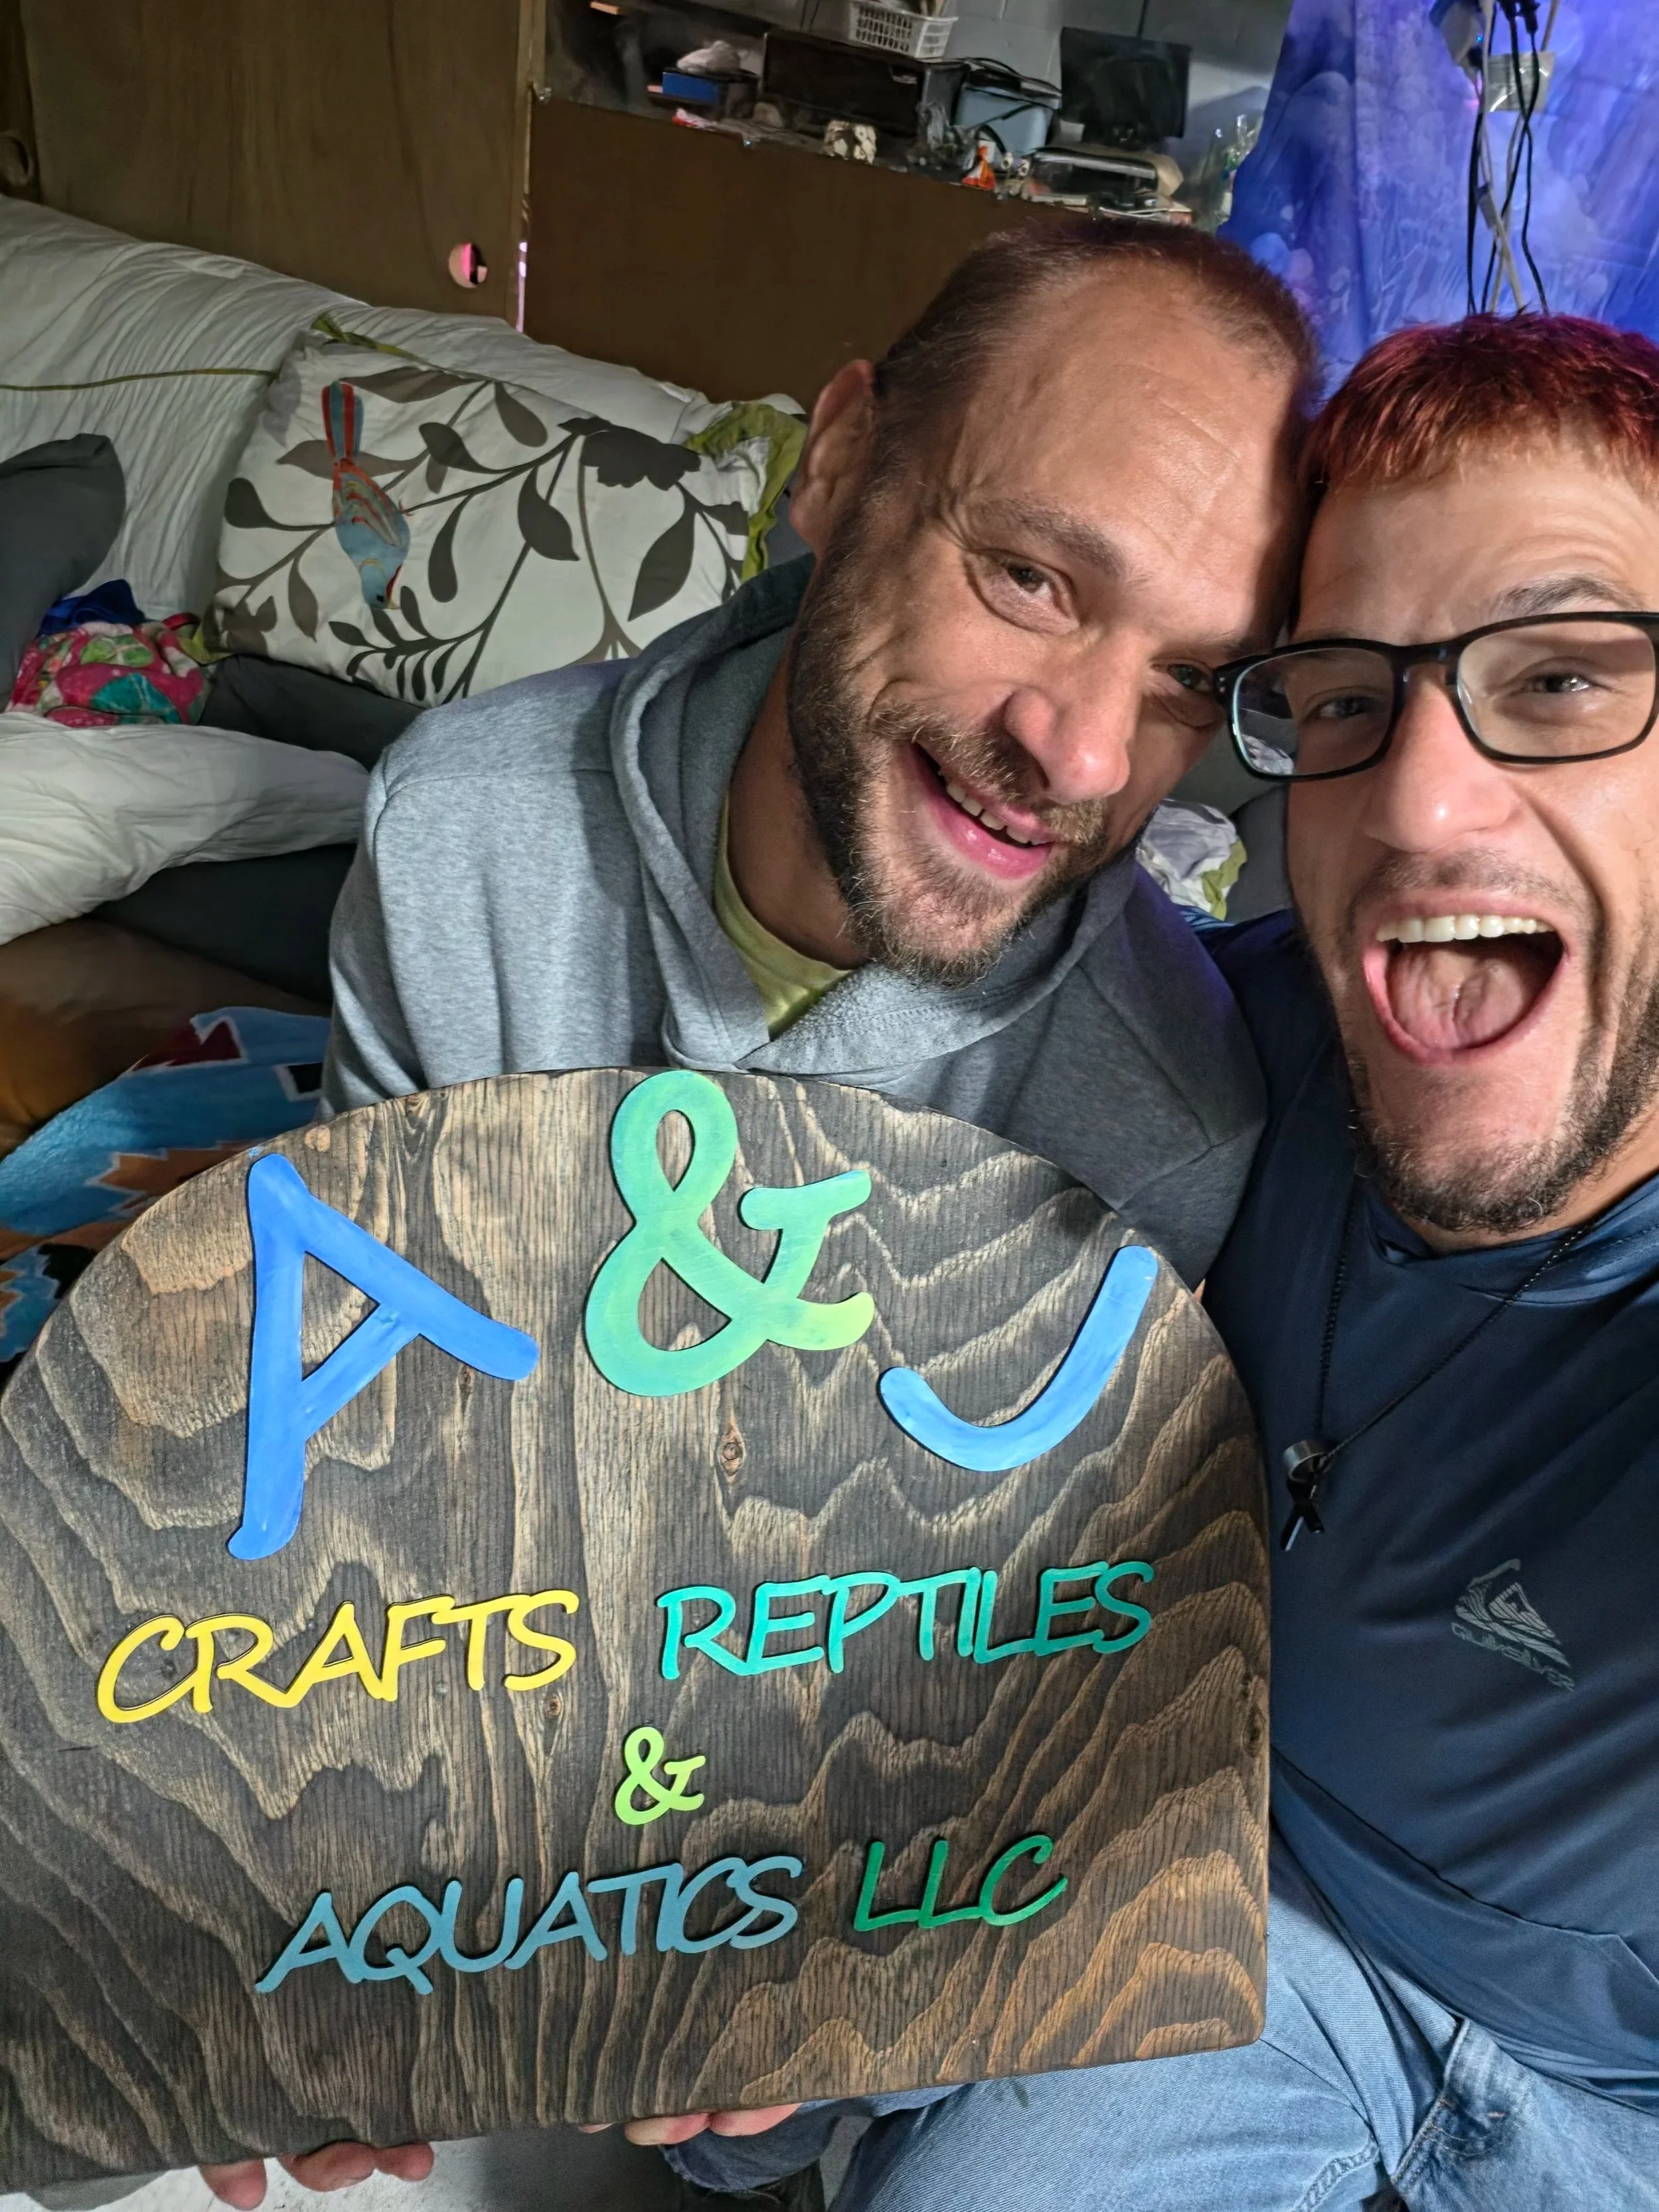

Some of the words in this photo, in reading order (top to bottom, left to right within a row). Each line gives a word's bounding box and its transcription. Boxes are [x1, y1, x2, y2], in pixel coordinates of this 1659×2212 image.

[228, 1153, 540, 1560] A
[585, 1070, 875, 1397] &
[878, 1245, 1158, 1472] J
[97, 1589, 580, 1724] CRAFTS
[657, 1561, 1154, 1680] REPTILES
[615, 1726, 706, 1826] &
[255, 1855, 803, 1994] AQUATICS
[853, 1834, 1069, 1932] LLC
